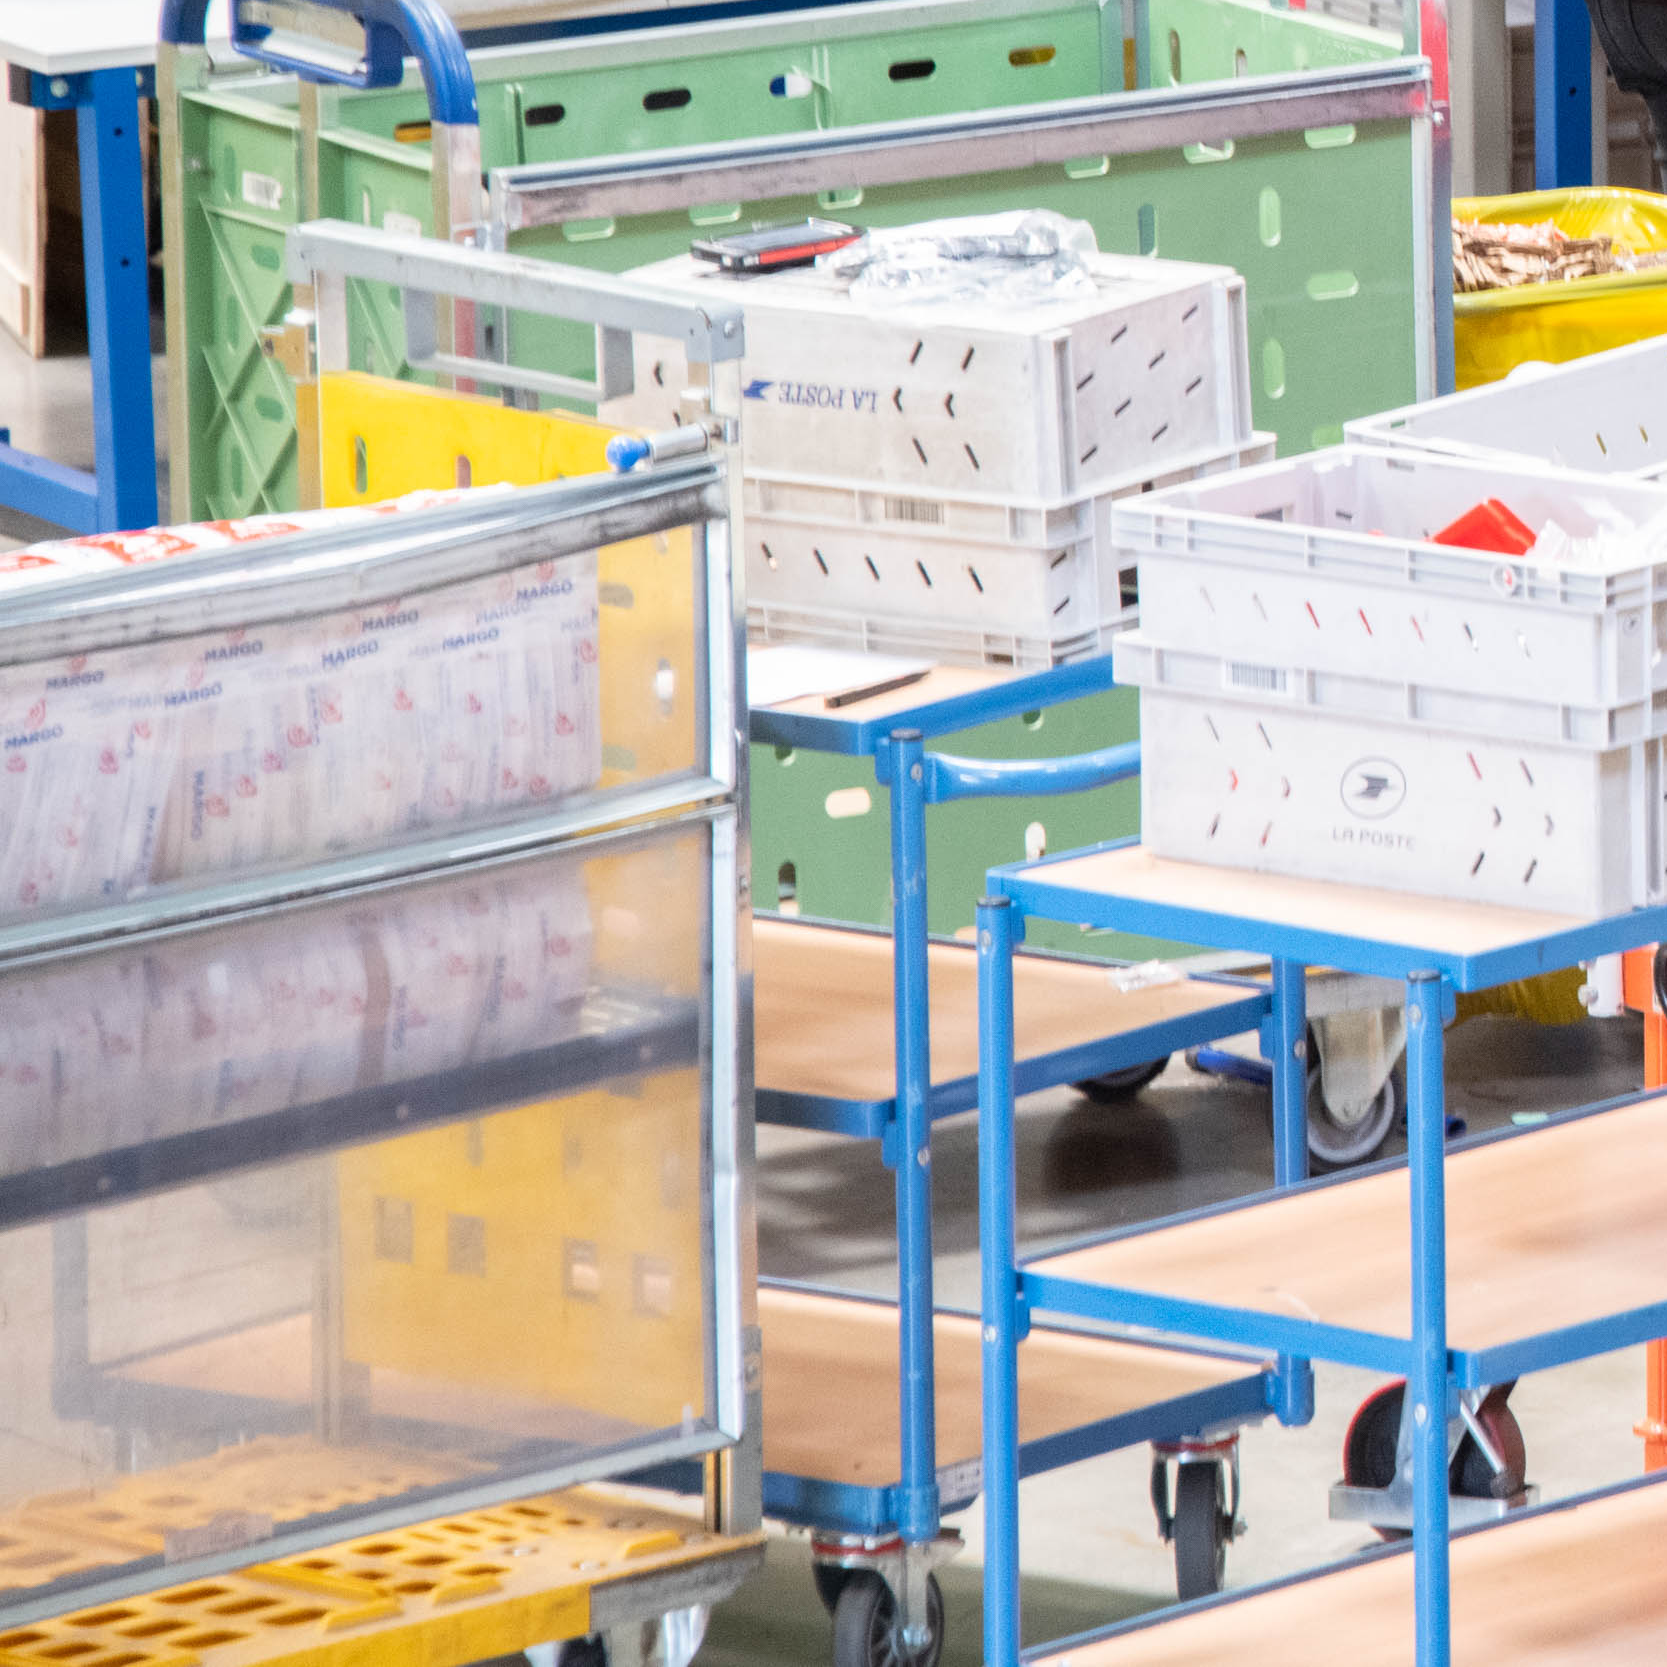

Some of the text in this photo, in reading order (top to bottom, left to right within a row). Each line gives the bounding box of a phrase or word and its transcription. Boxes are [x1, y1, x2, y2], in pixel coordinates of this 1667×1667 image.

[778, 381, 878, 413] LA POSTE
[516, 580, 573, 603] MARGO
[361, 609, 419, 634] MARGO
[204, 639, 263, 663] MARGO
[442, 627, 500, 652] MARGO
[321, 639, 379, 668] MARGO
[46, 669, 104, 692] MARGO
[164, 681, 223, 708] MARGO
[4, 724, 63, 751] MARGO
[1332, 825, 1416, 850] LA POSTE
